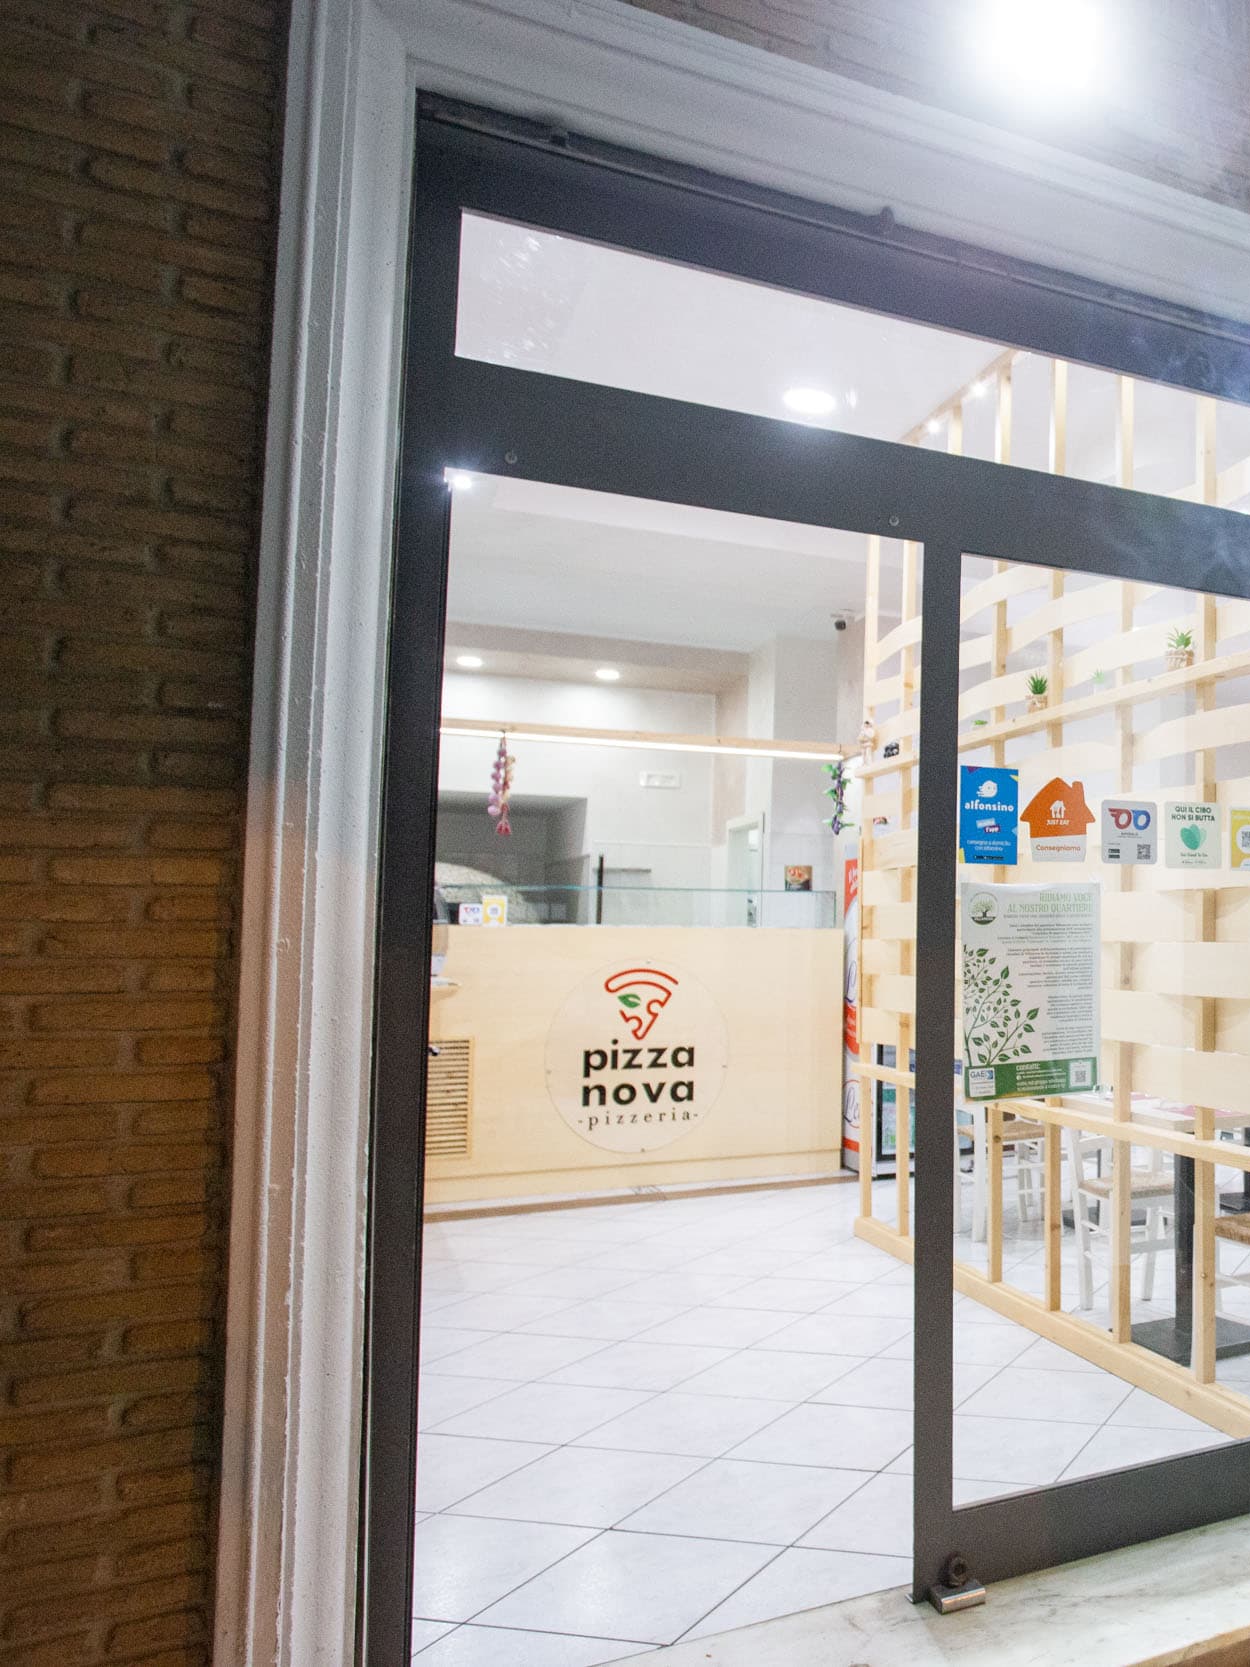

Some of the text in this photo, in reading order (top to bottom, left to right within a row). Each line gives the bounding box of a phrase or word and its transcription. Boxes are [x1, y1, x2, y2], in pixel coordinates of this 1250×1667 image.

[965, 800, 1014, 812] alfonsino
[1175, 806, 1212, 814] QUI IL CIBO
[1195, 814, 1215, 822] BUTTA
[1036, 844, 1081, 853] Consegniamo
[1007, 903, 1093, 913] AL NOSTRO QUARTIERE
[583, 1038, 695, 1078] pizza
[582, 1080, 694, 1107] nova
